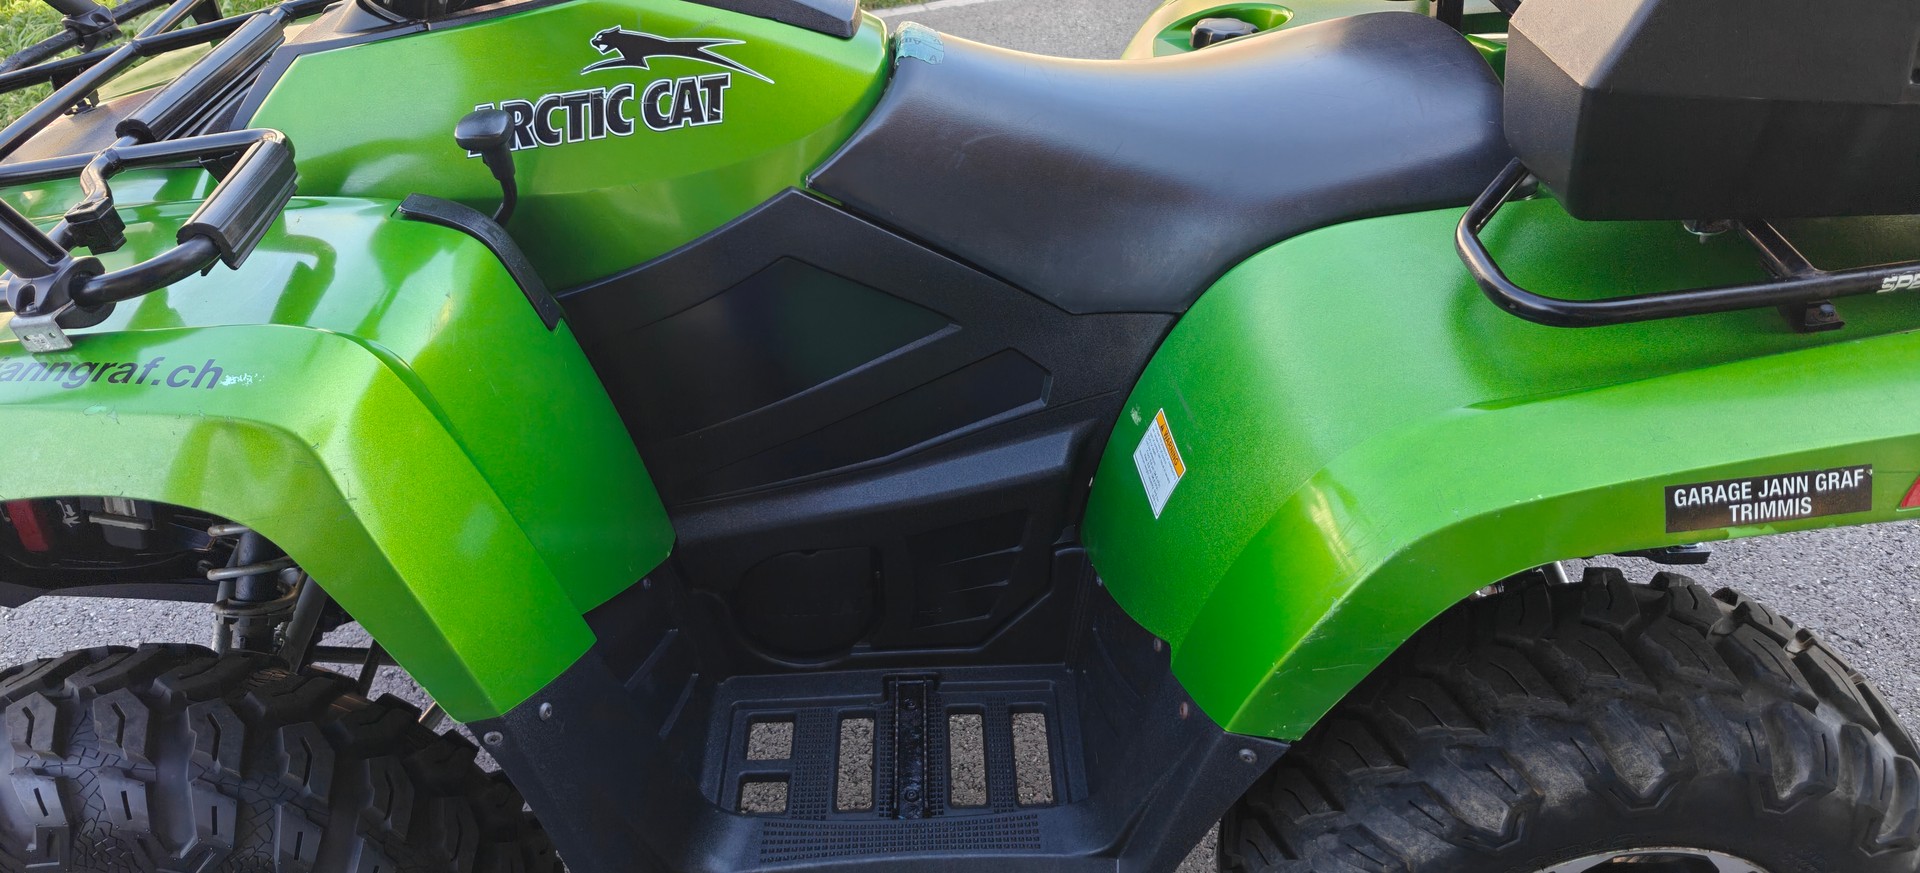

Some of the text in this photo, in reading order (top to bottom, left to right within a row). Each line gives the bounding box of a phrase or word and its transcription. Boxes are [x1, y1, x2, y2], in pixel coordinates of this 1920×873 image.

[468, 73, 731, 158] RCTIC CAT
[0, 356, 223, 390] anngraf.ch
[1674, 469, 1864, 507] GARAGE JANN GRAF
[1729, 497, 1812, 522] TRIMMIS
